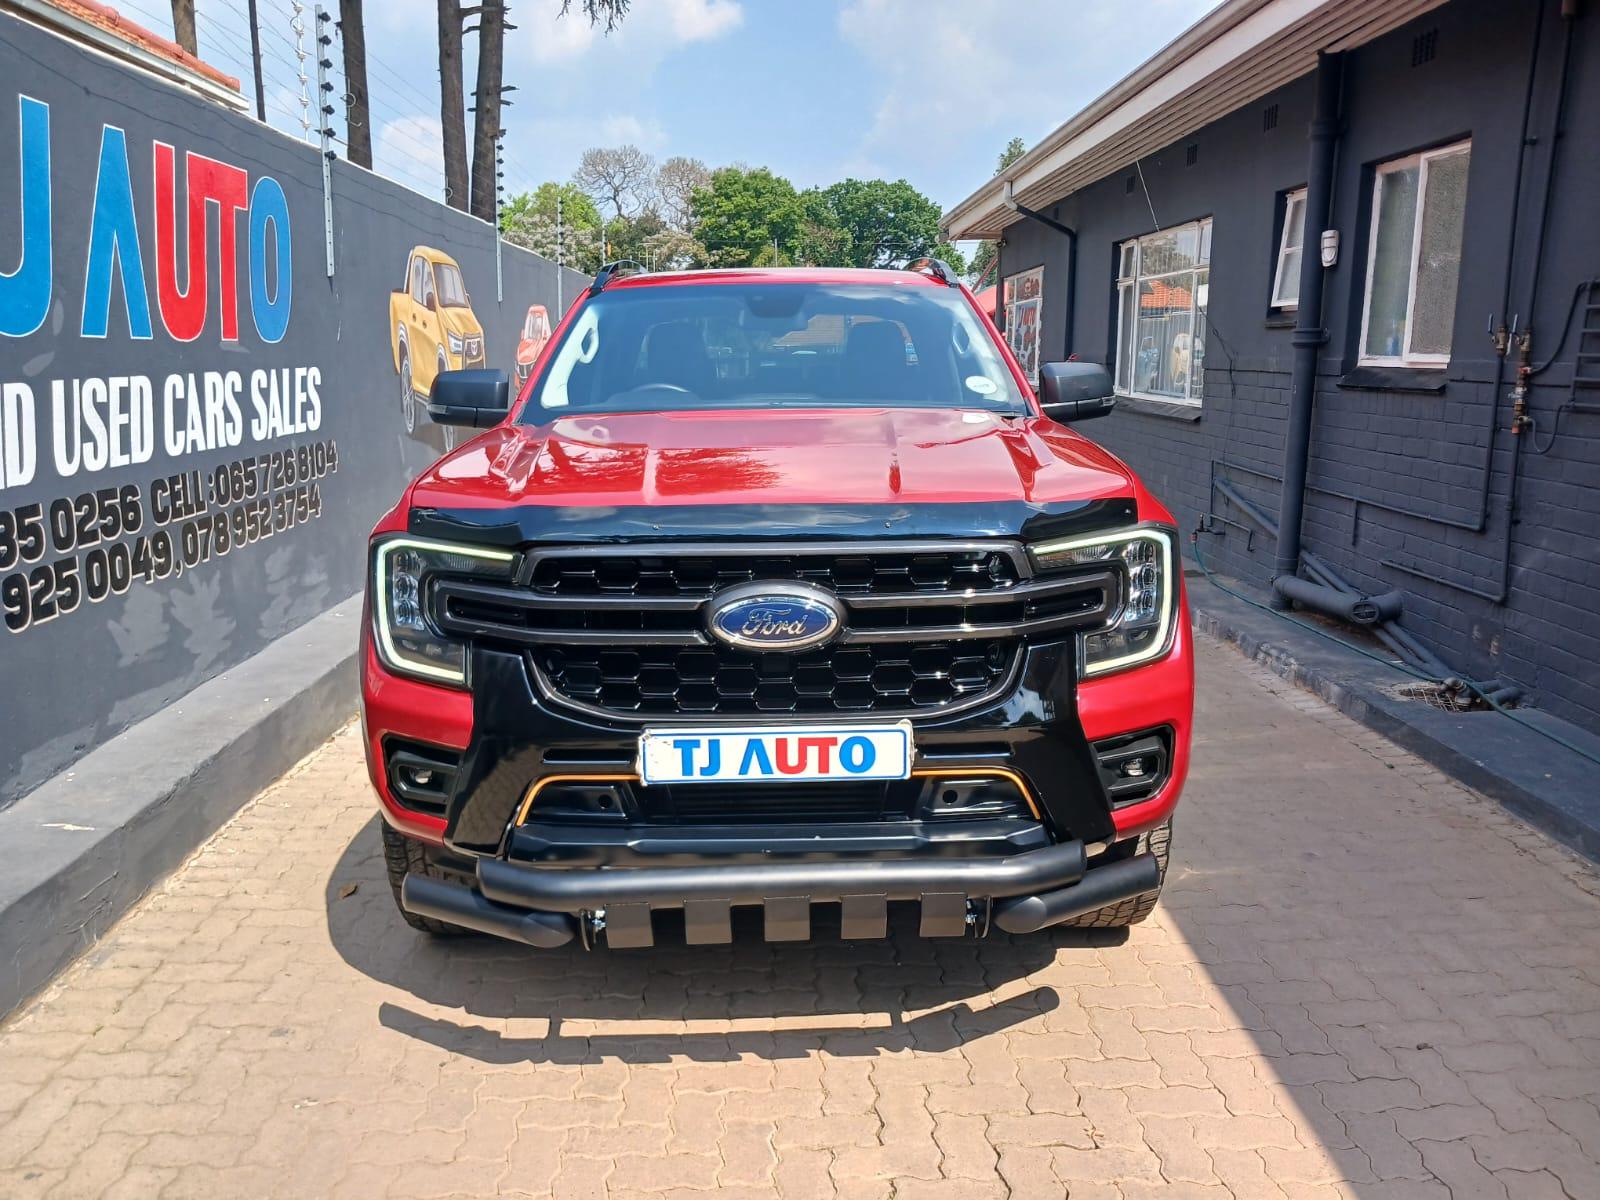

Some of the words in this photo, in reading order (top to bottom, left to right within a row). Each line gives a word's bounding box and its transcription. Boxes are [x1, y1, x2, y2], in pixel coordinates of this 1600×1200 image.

[80, 123, 292, 343] AUTO
[52, 375, 154, 477] USED
[163, 371, 243, 456] CARS
[250, 366, 322, 441] SALES
[50, 484, 144, 553] 0256
[259, 449, 297, 495] 726
[297, 439, 338, 482] 8104
[2, 555, 82, 633] 925
[232, 498, 274, 548] 952
[274, 483, 322, 532] 3754
[742, 607, 808, 636] Ford
[673, 738, 721, 777] TJ
[738, 735, 877, 776] AUTO
